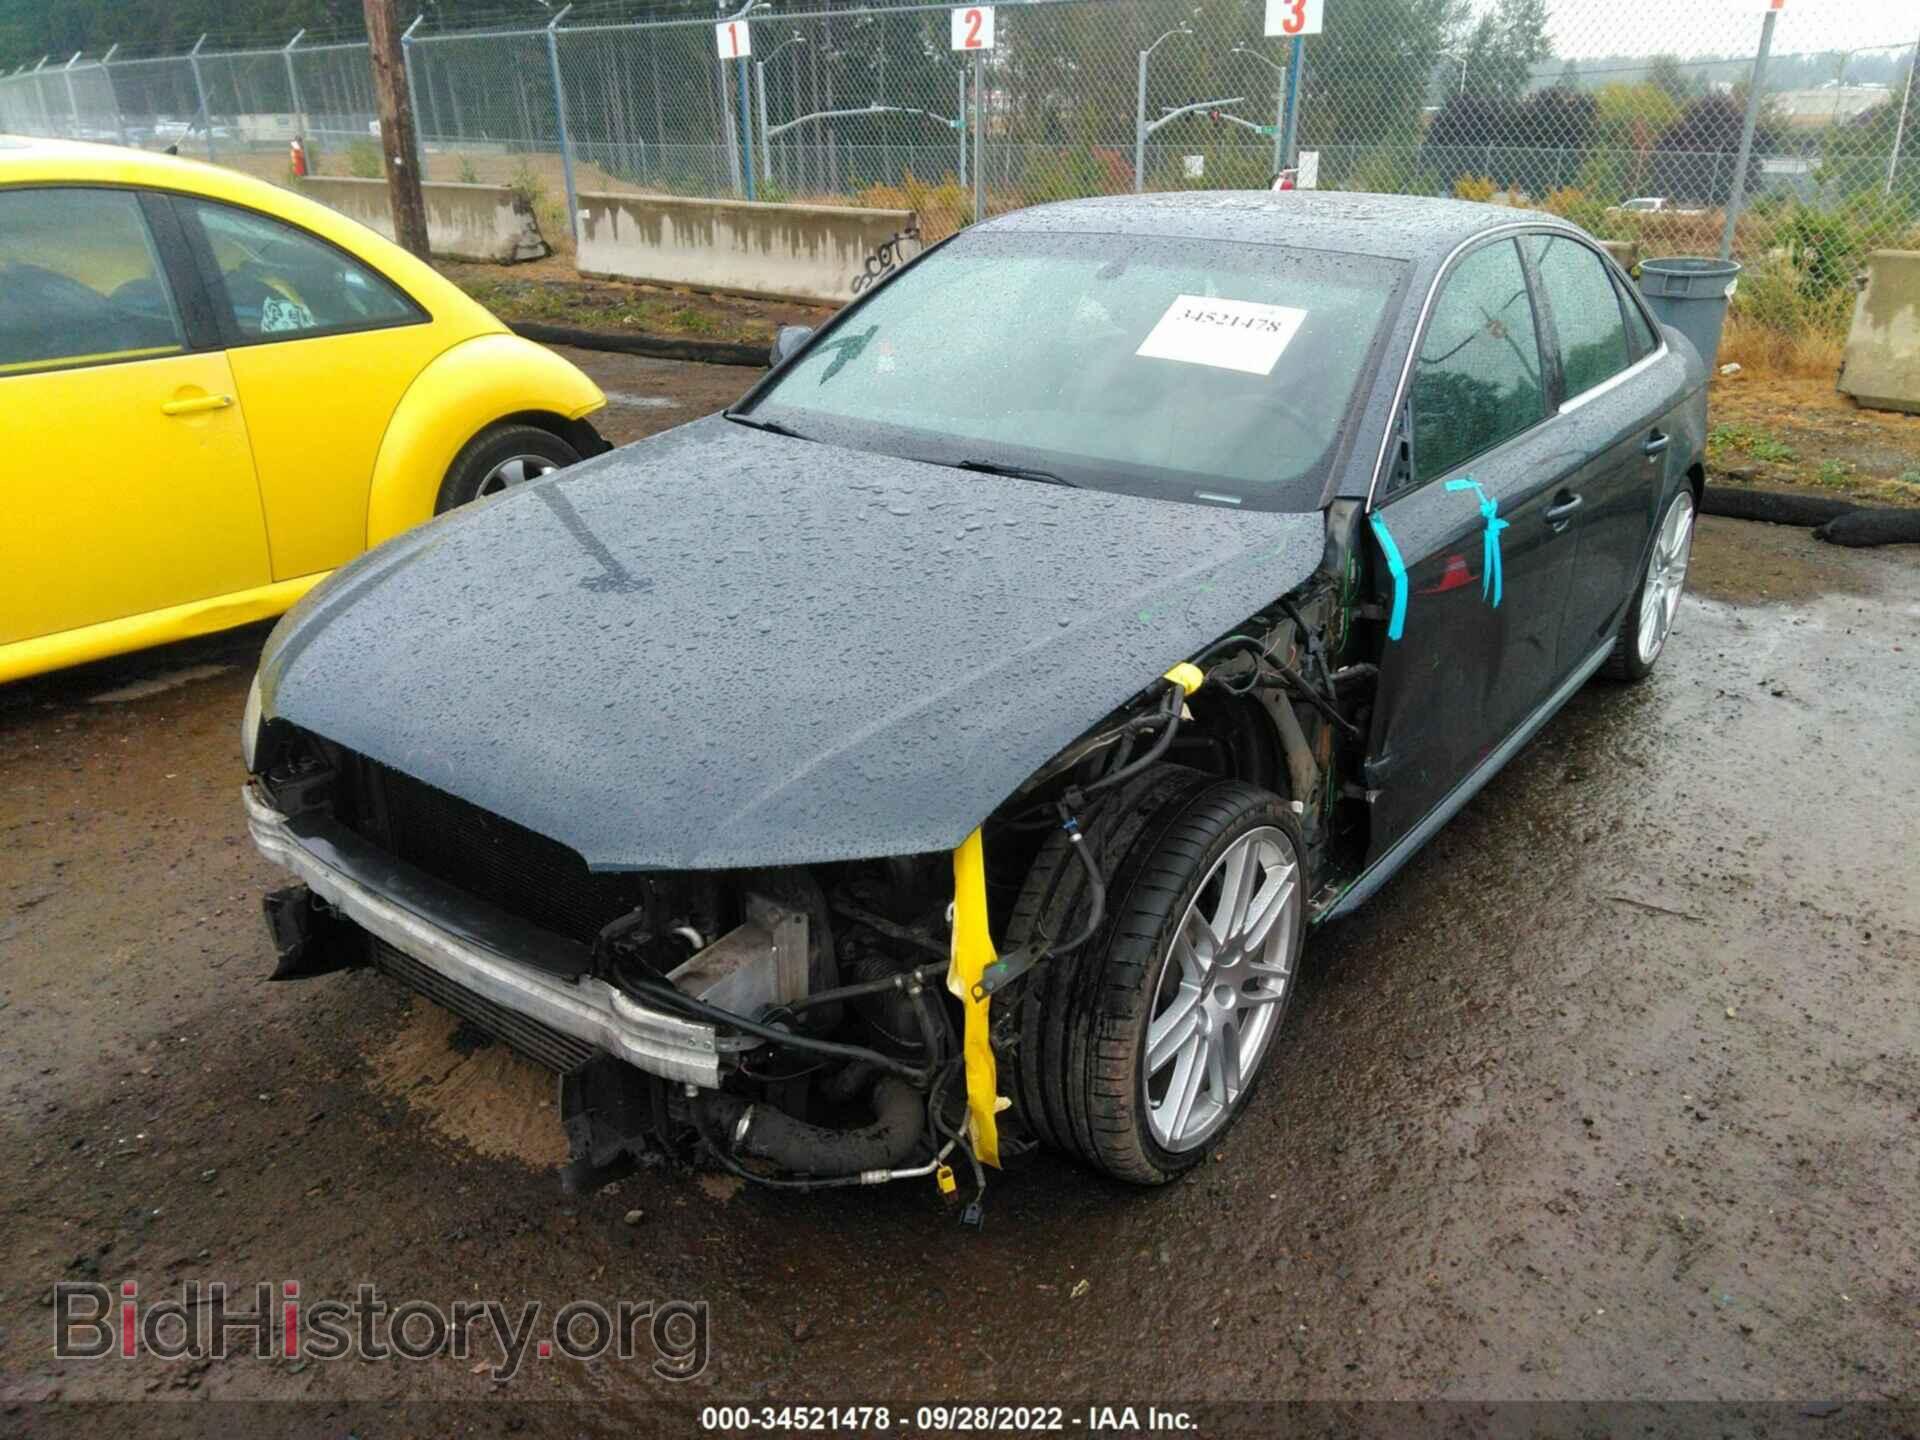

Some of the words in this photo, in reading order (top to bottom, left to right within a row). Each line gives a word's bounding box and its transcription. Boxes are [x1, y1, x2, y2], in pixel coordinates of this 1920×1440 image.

[965, 9, 982, 48] 2
[1282, 0, 1305, 33] 3
[728, 22, 738, 56] 1
